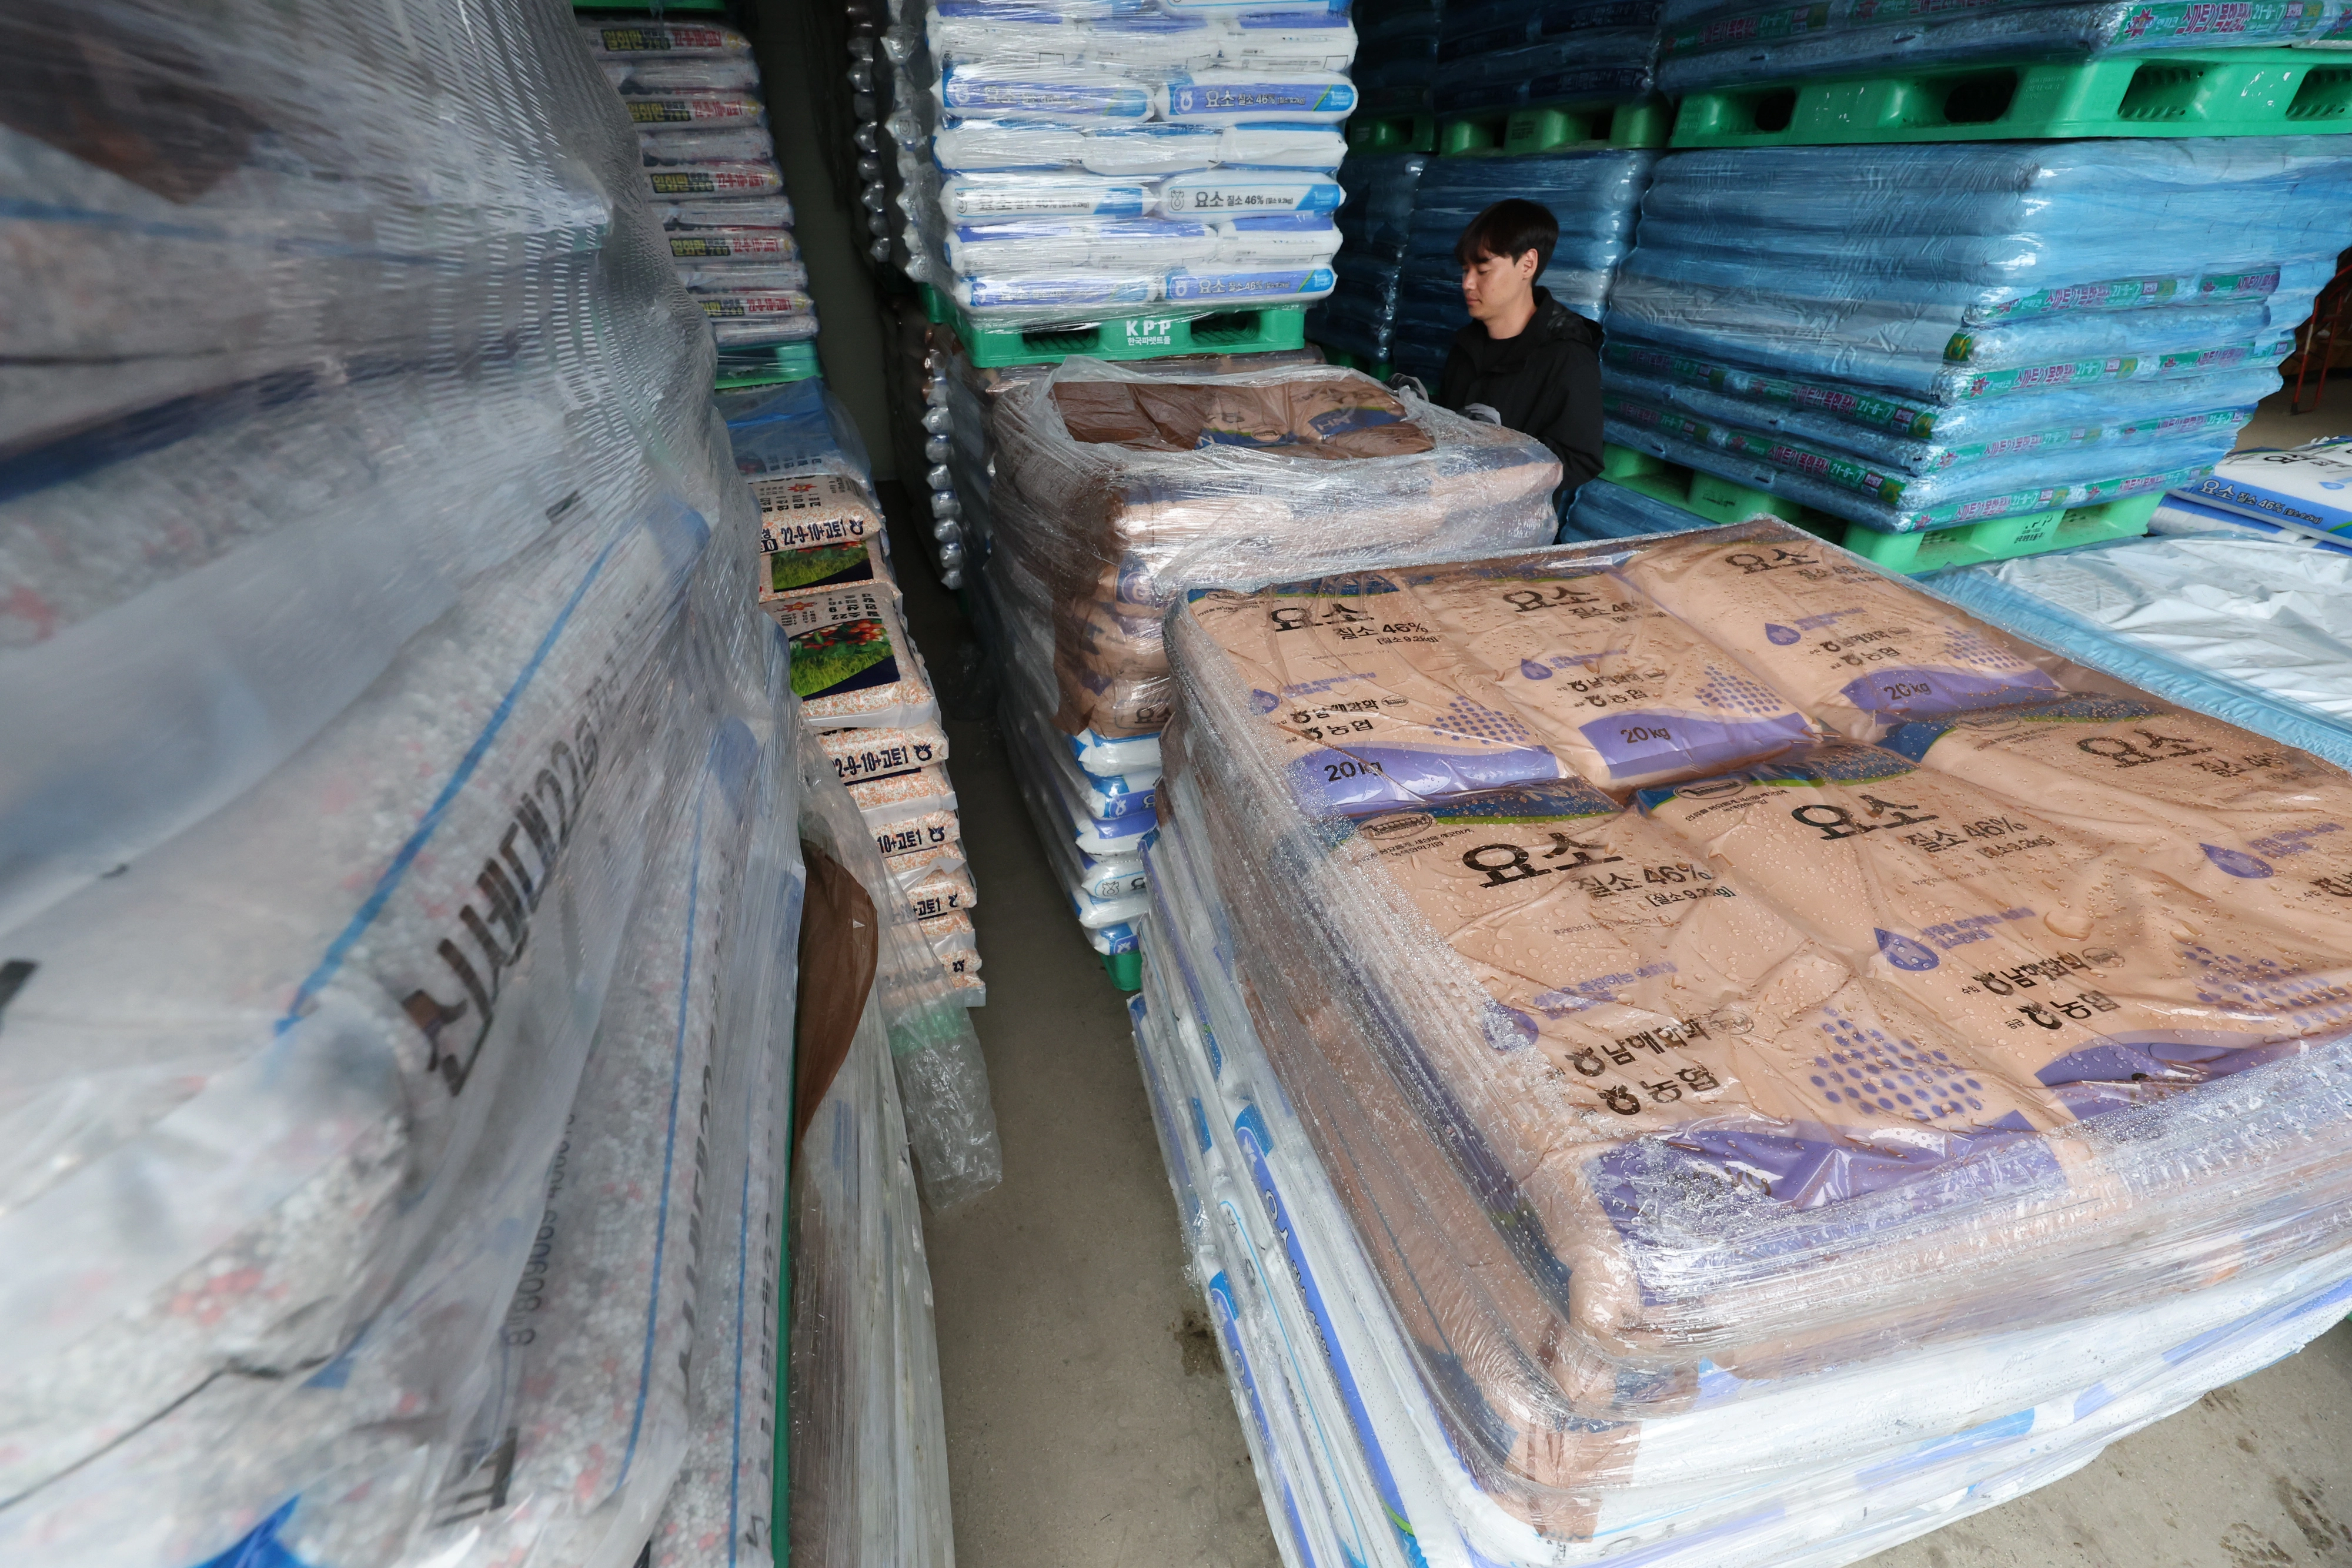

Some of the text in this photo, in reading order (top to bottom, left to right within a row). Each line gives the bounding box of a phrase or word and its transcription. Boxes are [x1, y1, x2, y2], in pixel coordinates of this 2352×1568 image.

[1205, 89, 1234, 108] 요소
[1238, 96, 1254, 106] 질소
[1256, 94, 1275, 105] 46%
[1195, 191, 1224, 208] 요소
[1227, 195, 1242, 205] 질소
[1245, 195, 1264, 205] 46%
[1198, 279, 1225, 293] 요소
[1228, 282, 1243, 292] 질소
[1244, 280, 1263, 290] 46%
[1126, 319, 1171, 336] KPP
[1127, 336, 1171, 346] 한국파렛트풀
[2199, 479, 2236, 500] 요소
[2237, 492, 2258, 506] 질소
[2258, 499, 2286, 513] 46%
[781, 518, 847, 546] 22-9-10+고토1
[1725, 547, 1819, 574] 요소
[1503, 586, 1600, 613] 요소
[1271, 602, 1375, 632] 요소
[1569, 606, 1611, 619] 질소
[1333, 621, 1429, 640] 질소 46%
[1403, 635, 1439, 644] 9.2kg]
[1861, 647, 1900, 661] 농협
[1883, 681, 1932, 700] 20kg
[1312, 699, 1379, 719] 남해화학
[1327, 719, 1374, 735] 농협
[1620, 726, 1671, 744] 20kg
[2076, 728, 2213, 769] 요소
[1324, 760, 1384, 783] 20kg
[1792, 794, 1939, 841] 요소
[1415, 835, 1440, 846] 세상을
[1901, 815, 2029, 854] 질소 46%
[1462, 831, 1623, 888] 요소
[1571, 862, 1716, 898] 질소 46%
[1644, 889, 1685, 908] [질소
[2000, 950, 2092, 989] 남해화학
[2049, 989, 2122, 1020] 농협
[1601, 1019, 1712, 1066] 남해화학
[1638, 1064, 1722, 1104] 농협
